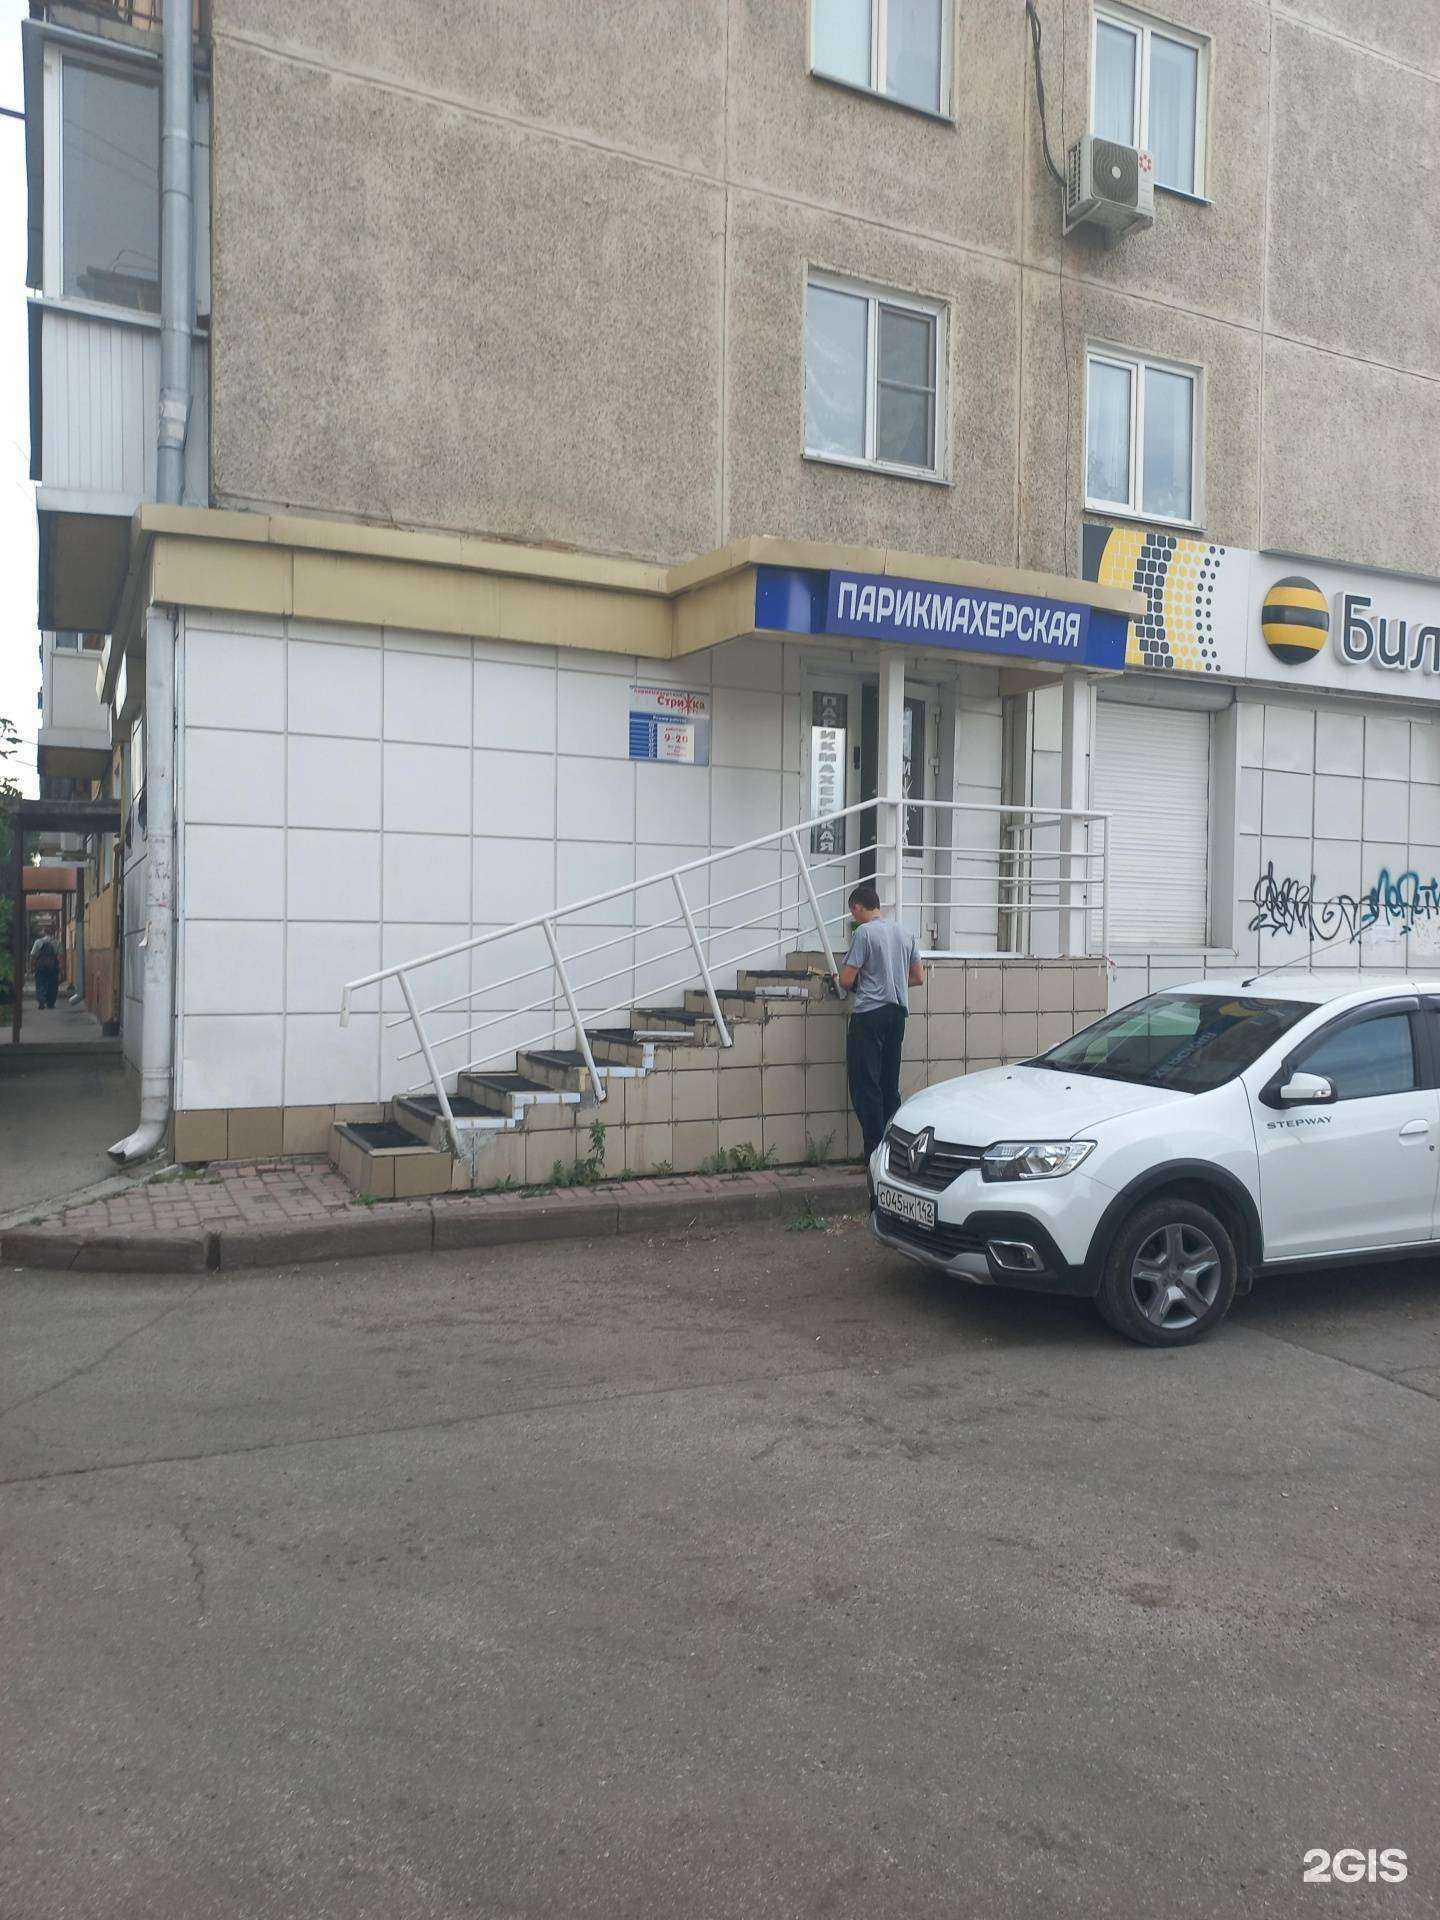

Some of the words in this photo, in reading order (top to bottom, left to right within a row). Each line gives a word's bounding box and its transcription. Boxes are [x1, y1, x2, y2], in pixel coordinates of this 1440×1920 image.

[837, 581, 1081, 648] ПАРИКМАХЕРСКАЯ
[1341, 592, 1440, 673] Бил
[1266, 1116, 1333, 1130] STEPWAY
